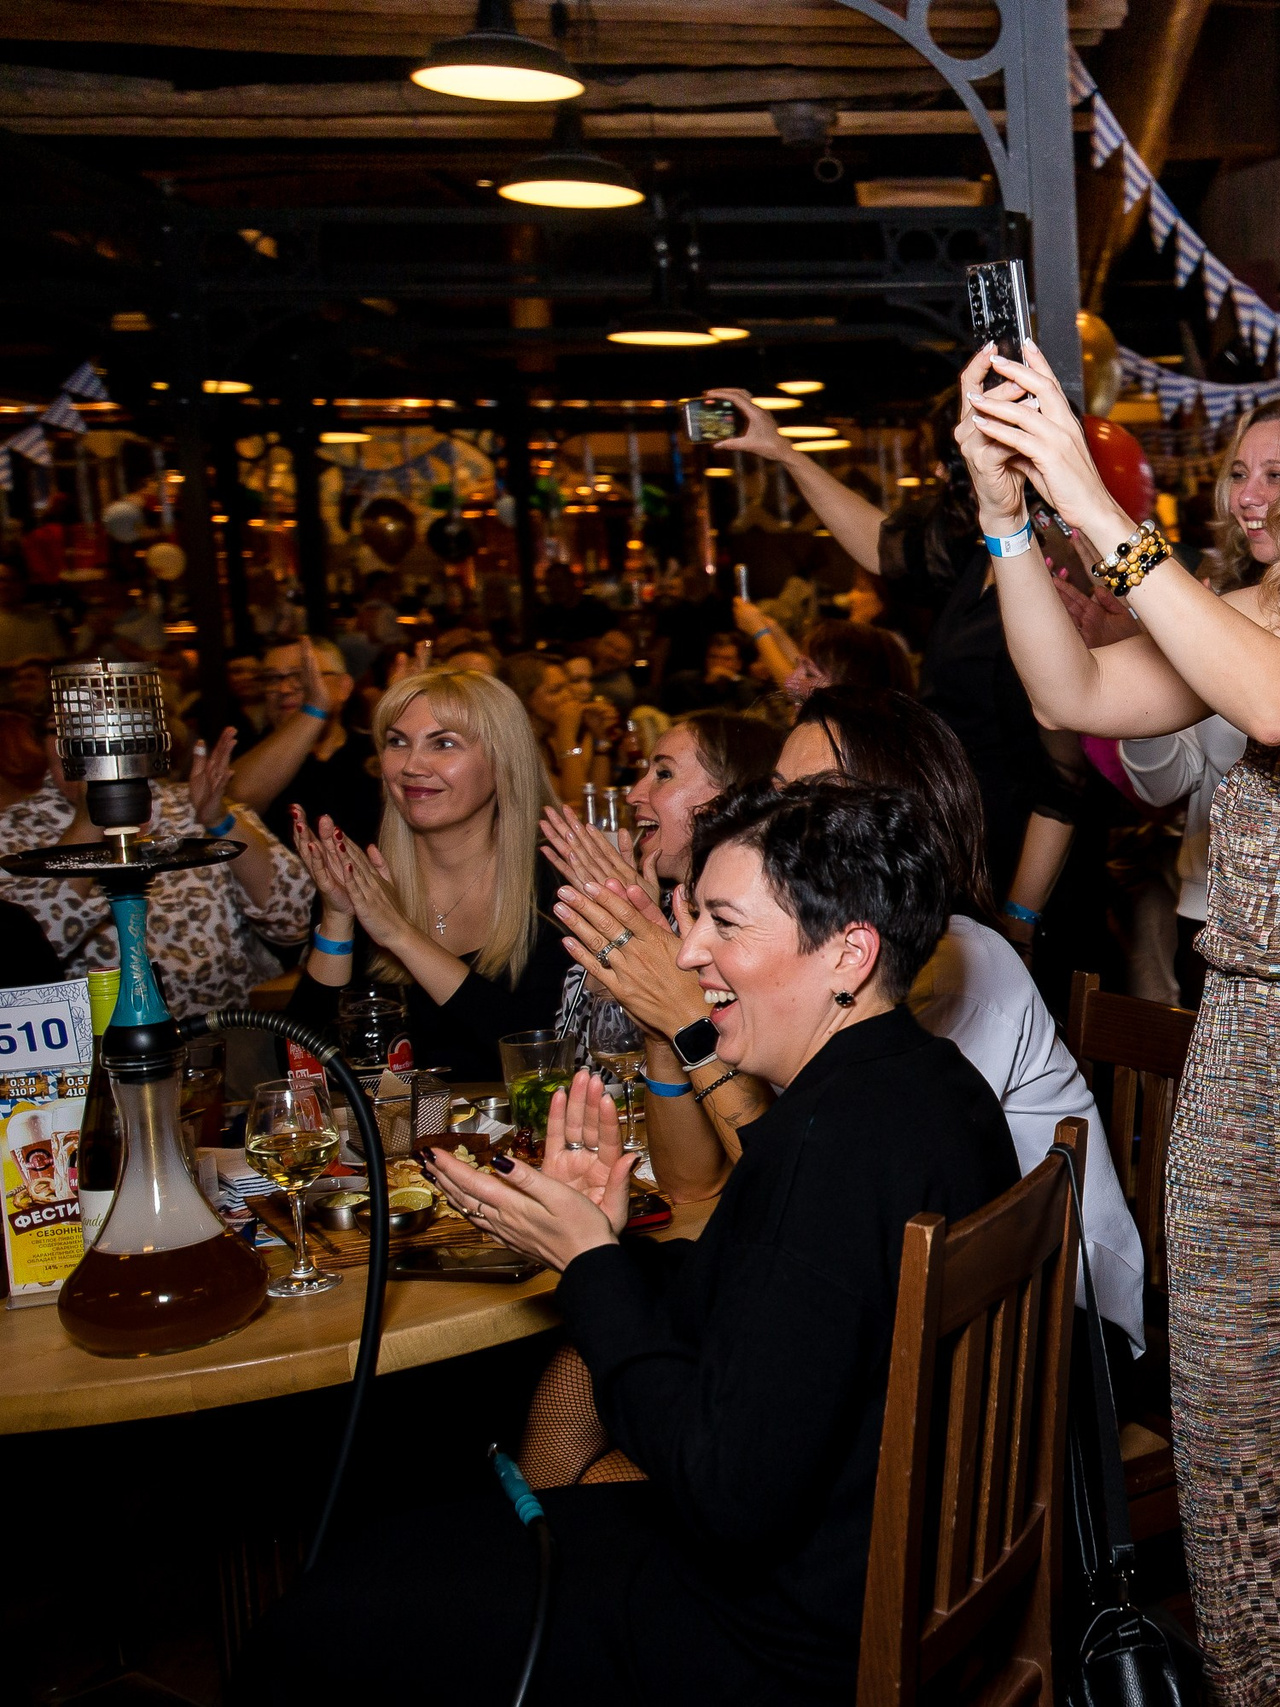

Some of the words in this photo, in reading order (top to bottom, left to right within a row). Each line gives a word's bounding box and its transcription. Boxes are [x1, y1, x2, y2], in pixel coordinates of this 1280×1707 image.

[0, 1017, 69, 1055] 510
[10, 1078, 26, 1087] 0,3
[28, 1077, 36, 1085] Л
[67, 1077, 84, 1086] 0,5
[9, 1088, 27, 1097] 310
[66, 1087, 86, 1097] 410
